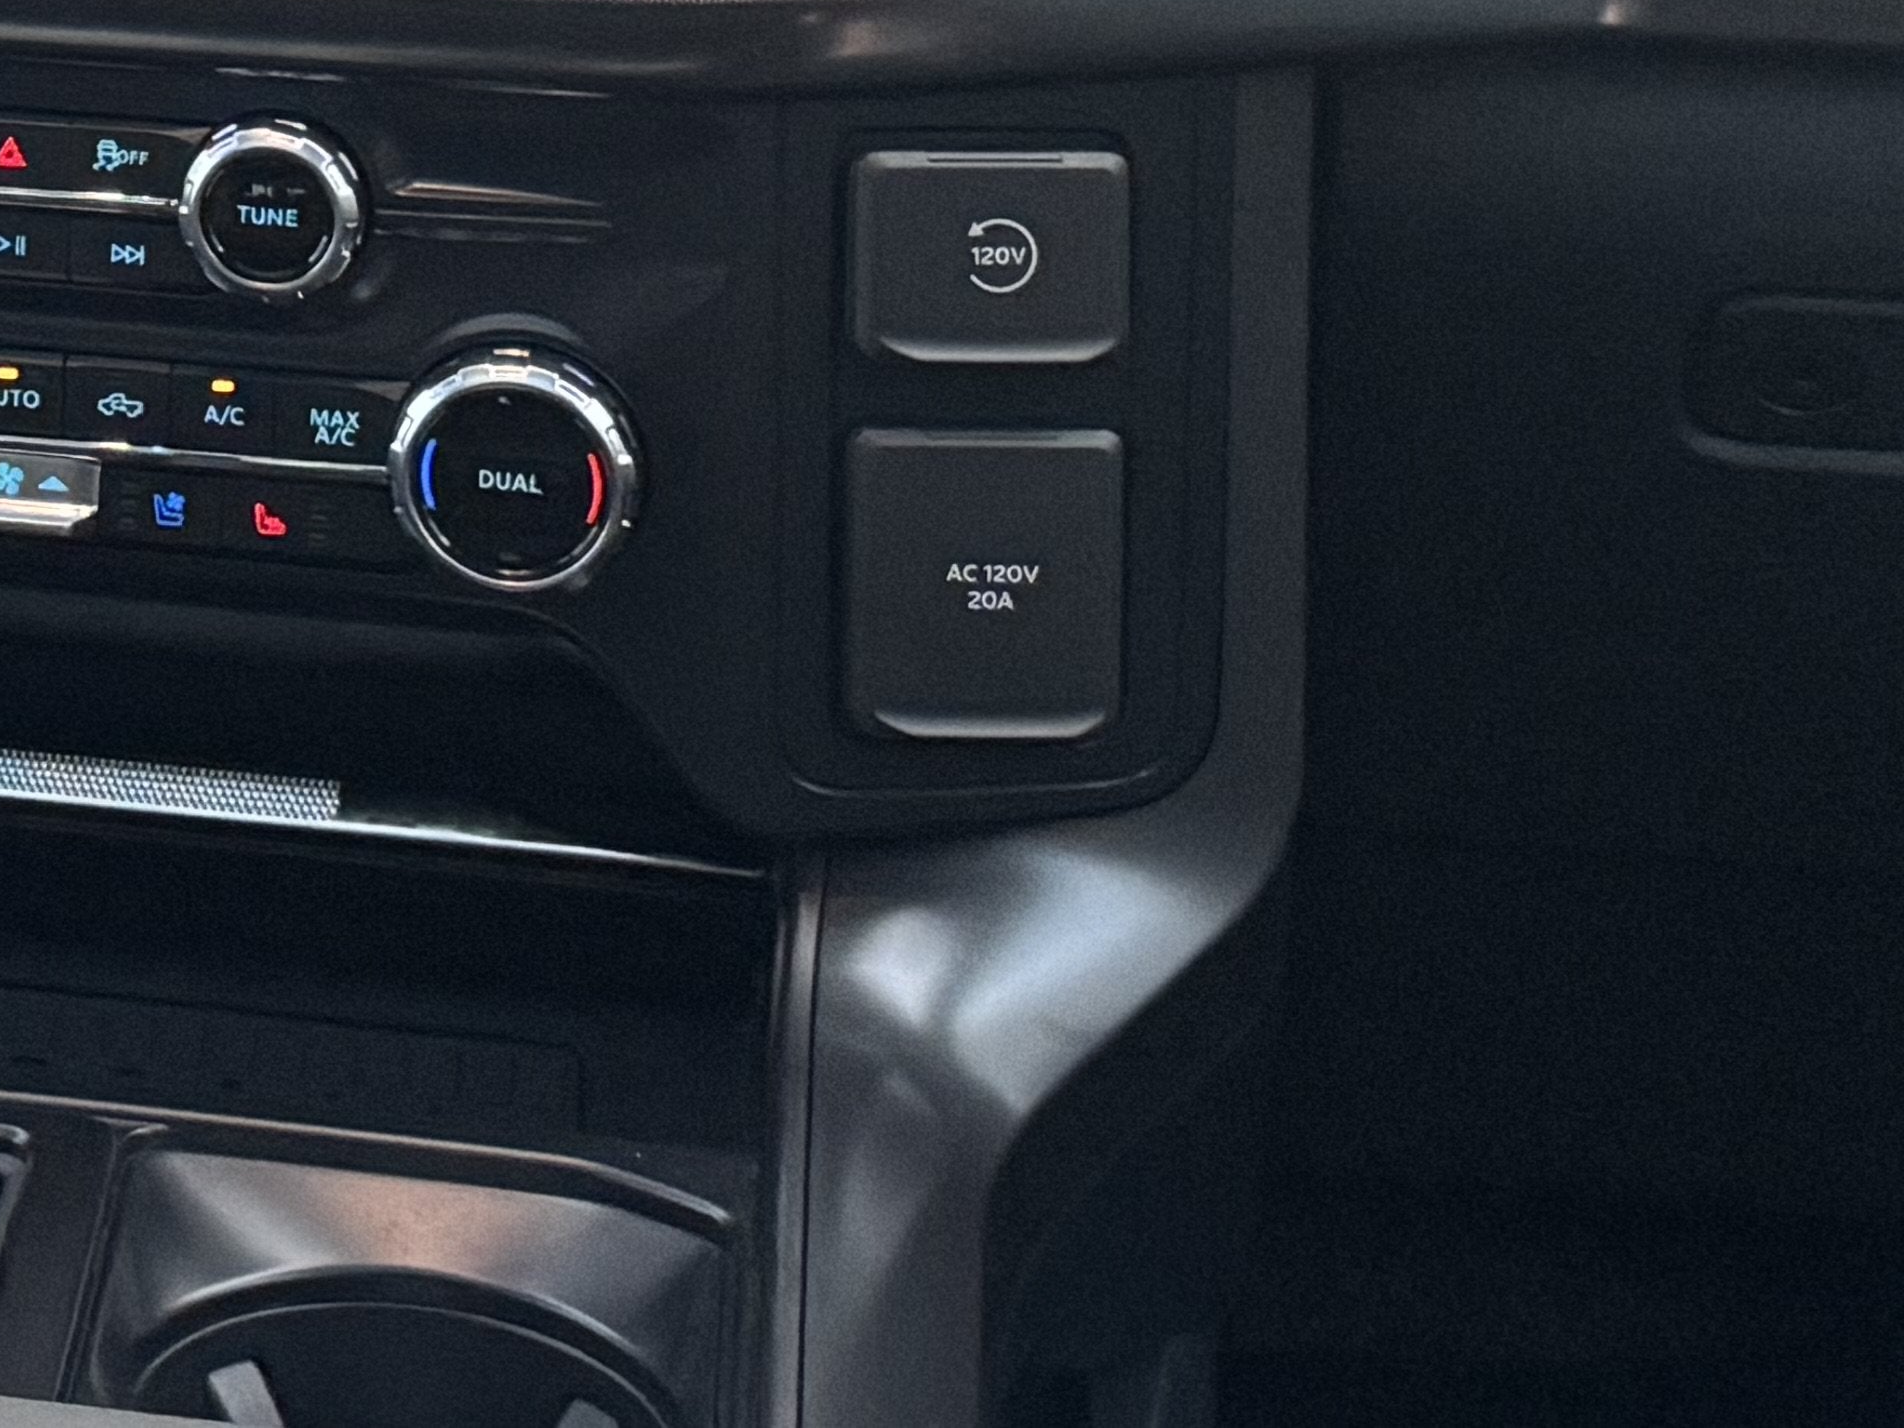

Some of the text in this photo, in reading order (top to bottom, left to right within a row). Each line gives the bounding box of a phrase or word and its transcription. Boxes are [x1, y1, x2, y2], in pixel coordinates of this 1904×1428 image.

[119, 149, 149, 166] OFF
[236, 204, 299, 229] TUNE
[970, 245, 1027, 266] 120V
[203, 404, 246, 426] A/C
[310, 407, 361, 430] MAX
[313, 427, 356, 447] A/C
[477, 469, 544, 496] DUAL
[946, 564, 1040, 584] AC 120V
[967, 590, 1014, 611] 20A
